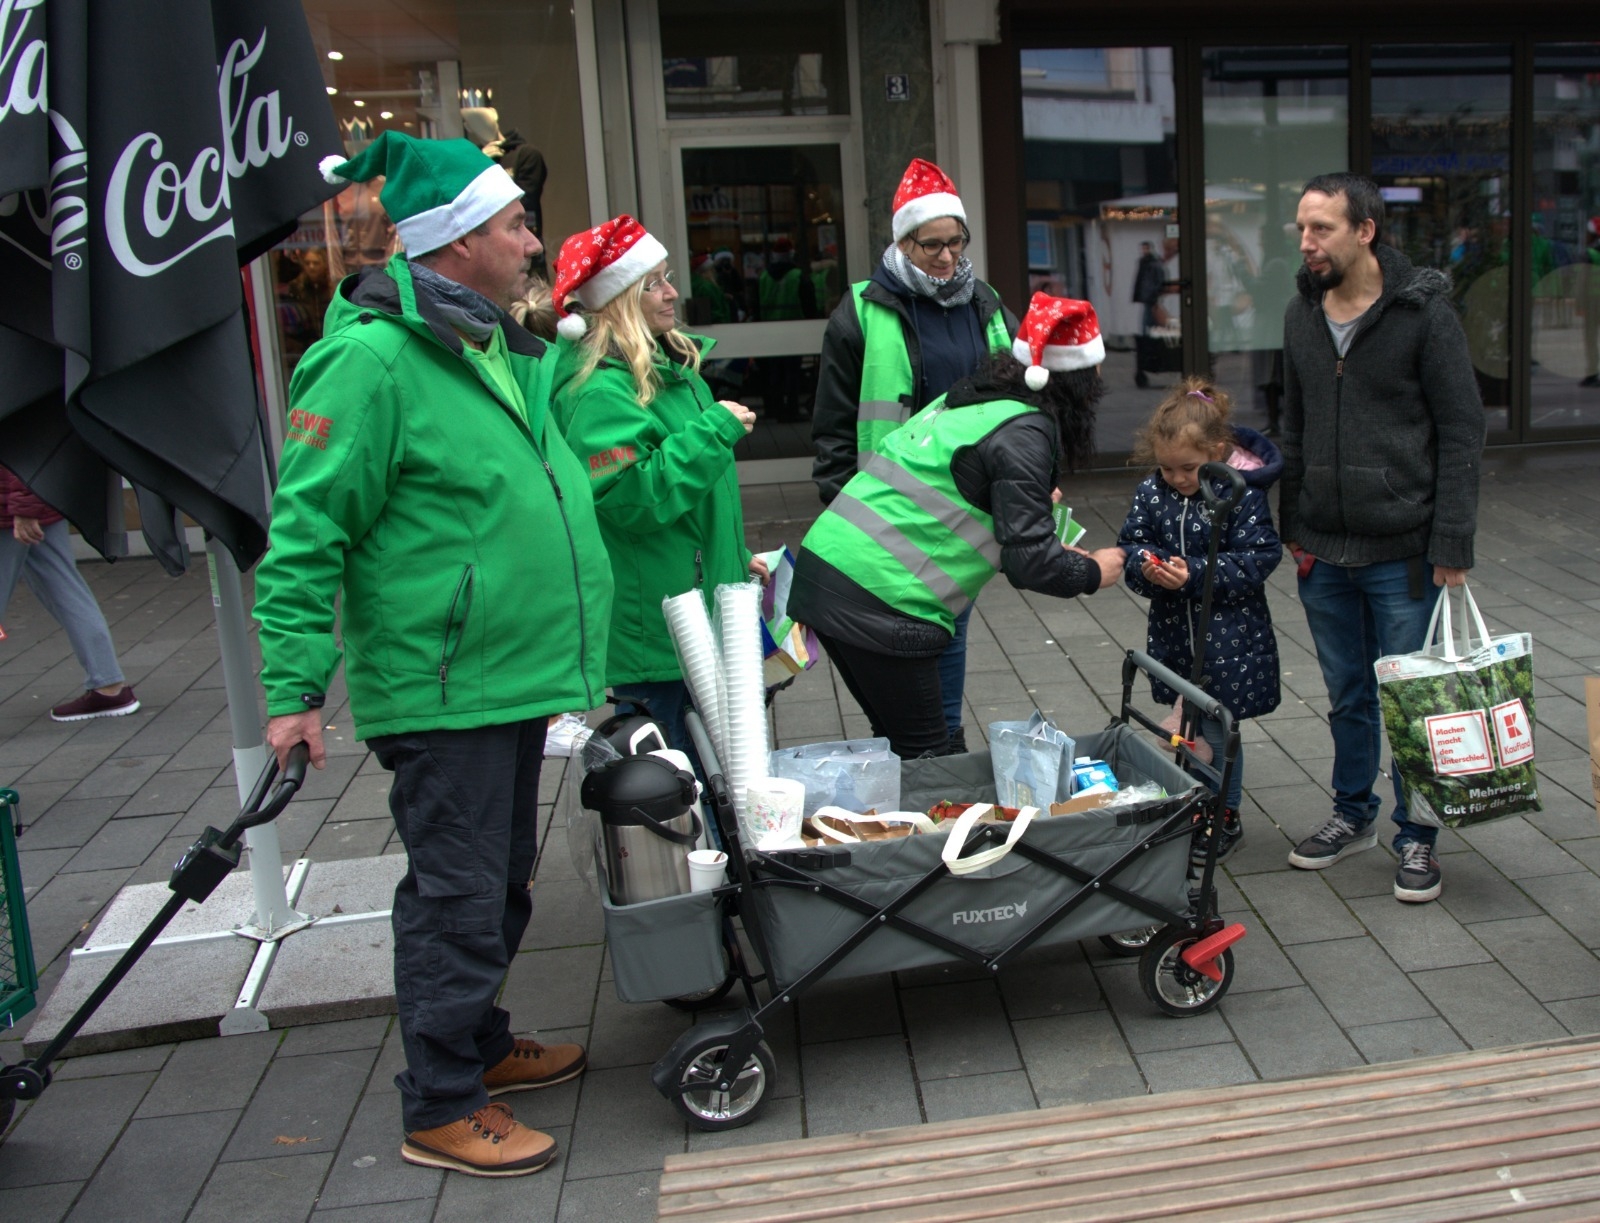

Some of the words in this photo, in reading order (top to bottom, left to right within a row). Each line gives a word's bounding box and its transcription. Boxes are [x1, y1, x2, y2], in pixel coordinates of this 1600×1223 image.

[890, 76, 904, 94] 3
[589, 445, 637, 470] REWE
[1435, 727, 1466, 736] Machen
[1437, 737, 1462, 746] macht
[1504, 738, 1531, 755] Kaufland
[1441, 753, 1487, 765] Unterschied.
[1443, 804, 1467, 815] Gut
[1469, 803, 1488, 814] für
[1490, 798, 1506, 809] die
[952, 905, 1015, 925] FUXTEC
